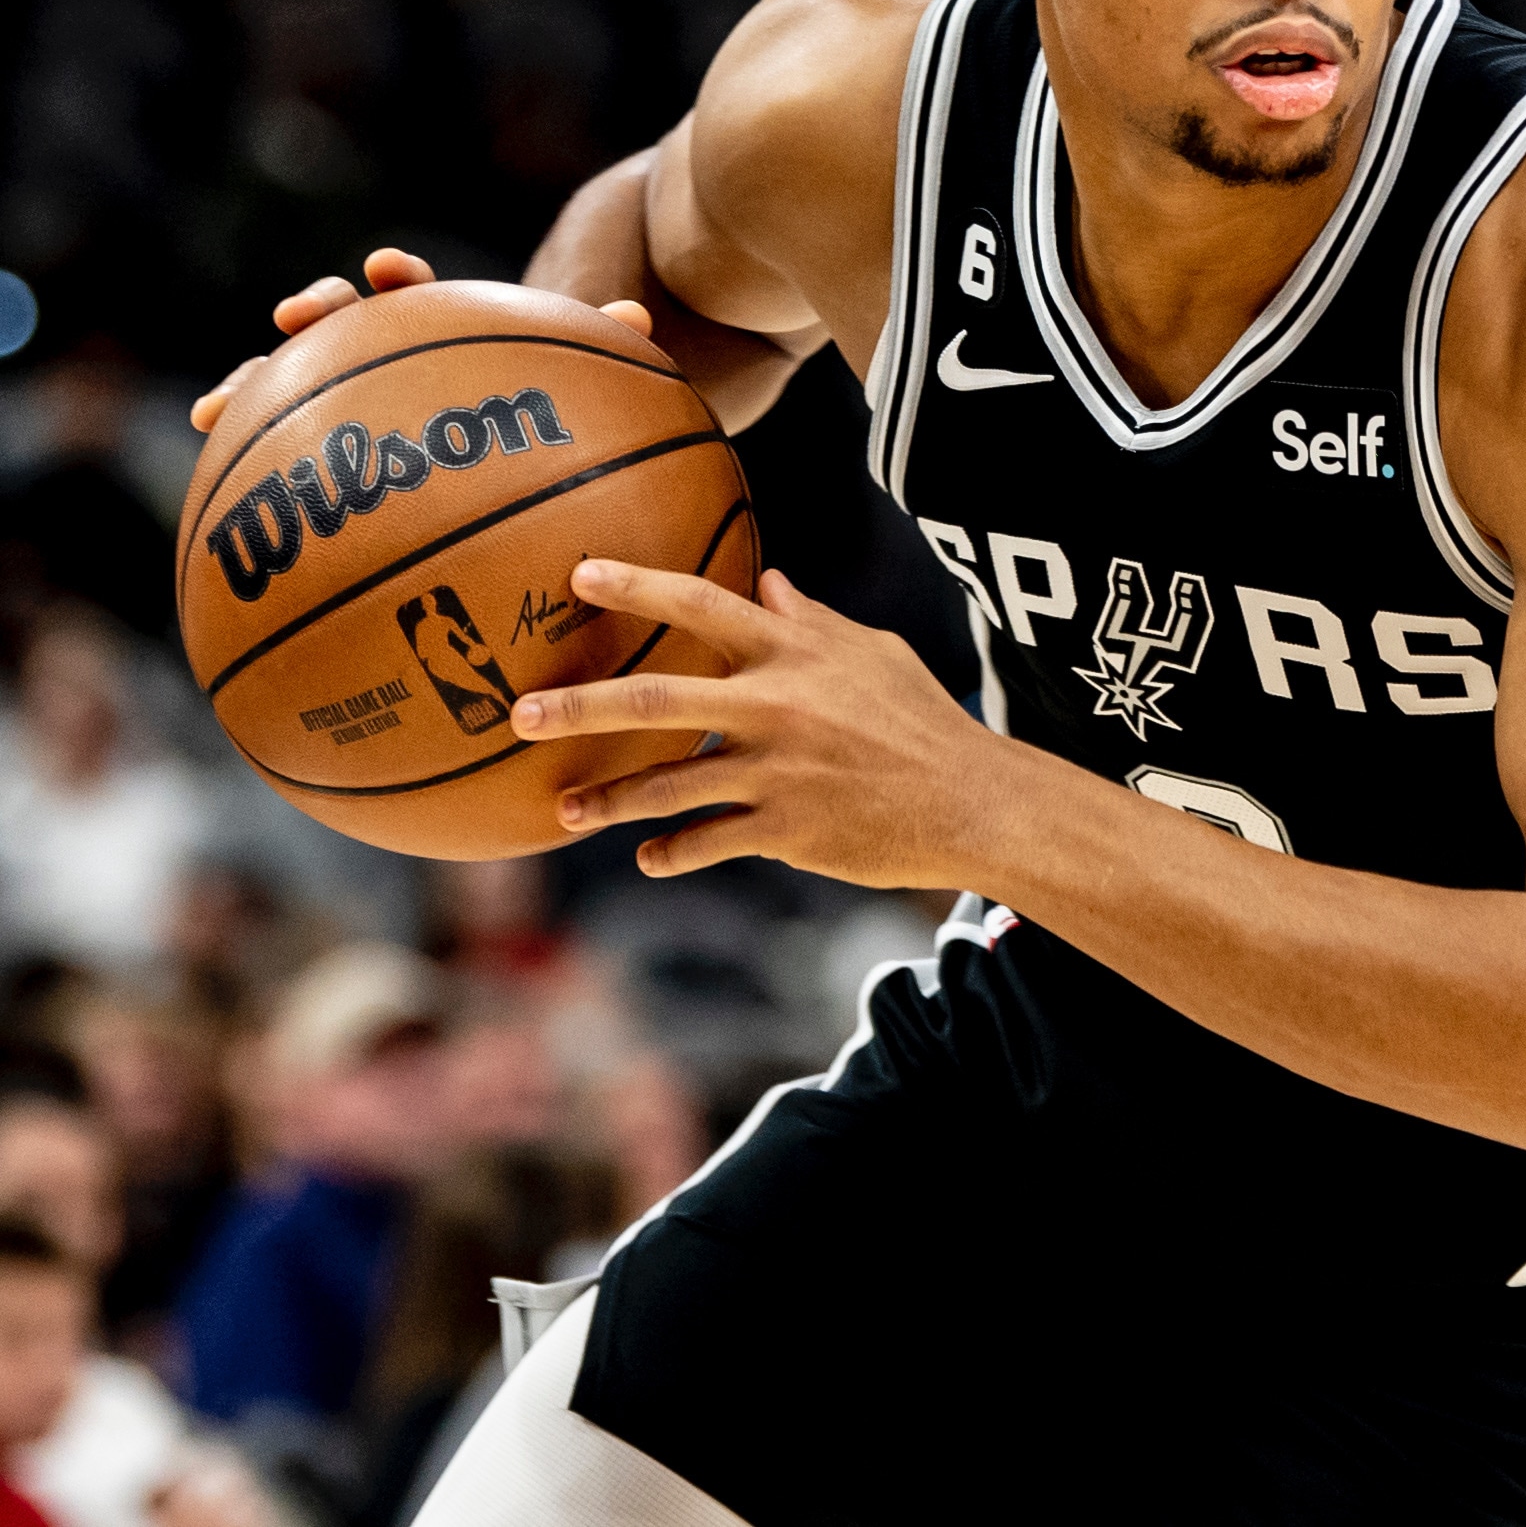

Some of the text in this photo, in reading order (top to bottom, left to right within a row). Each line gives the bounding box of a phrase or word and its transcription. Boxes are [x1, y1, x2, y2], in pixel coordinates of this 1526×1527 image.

[957, 223, 998, 303] 6
[206, 387, 574, 601] Wilson
[299, 678, 412, 733] OFFICIAL GAME BALL
